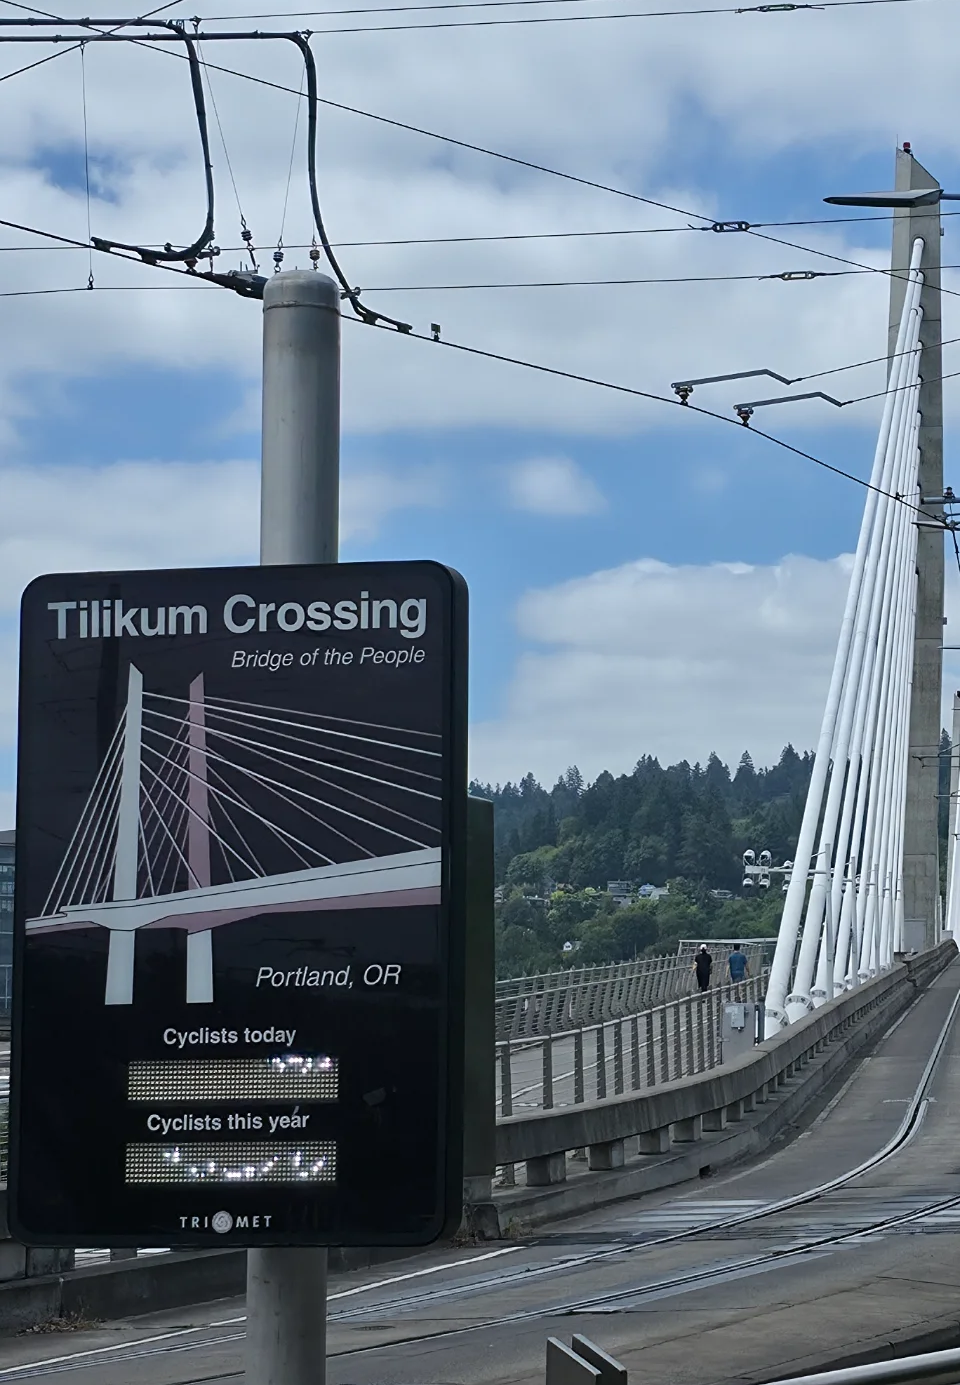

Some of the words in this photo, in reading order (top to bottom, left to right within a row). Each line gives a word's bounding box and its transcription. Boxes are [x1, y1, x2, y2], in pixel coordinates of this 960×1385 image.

[48, 599, 208, 640] Tilikum
[223, 591, 427, 639] Crossing
[231, 648, 294, 672] Bridge
[299, 647, 320, 666] of
[323, 646, 354, 666] the
[359, 645, 426, 668] People
[255, 965, 355, 990] Portland,
[363, 964, 402, 986] OR
[163, 1027, 239, 1049] Cyclists
[243, 1026, 297, 1047] today
[147, 1113, 222, 1135] Cyclists
[227, 1112, 263, 1130] this
[268, 1114, 310, 1133] year
